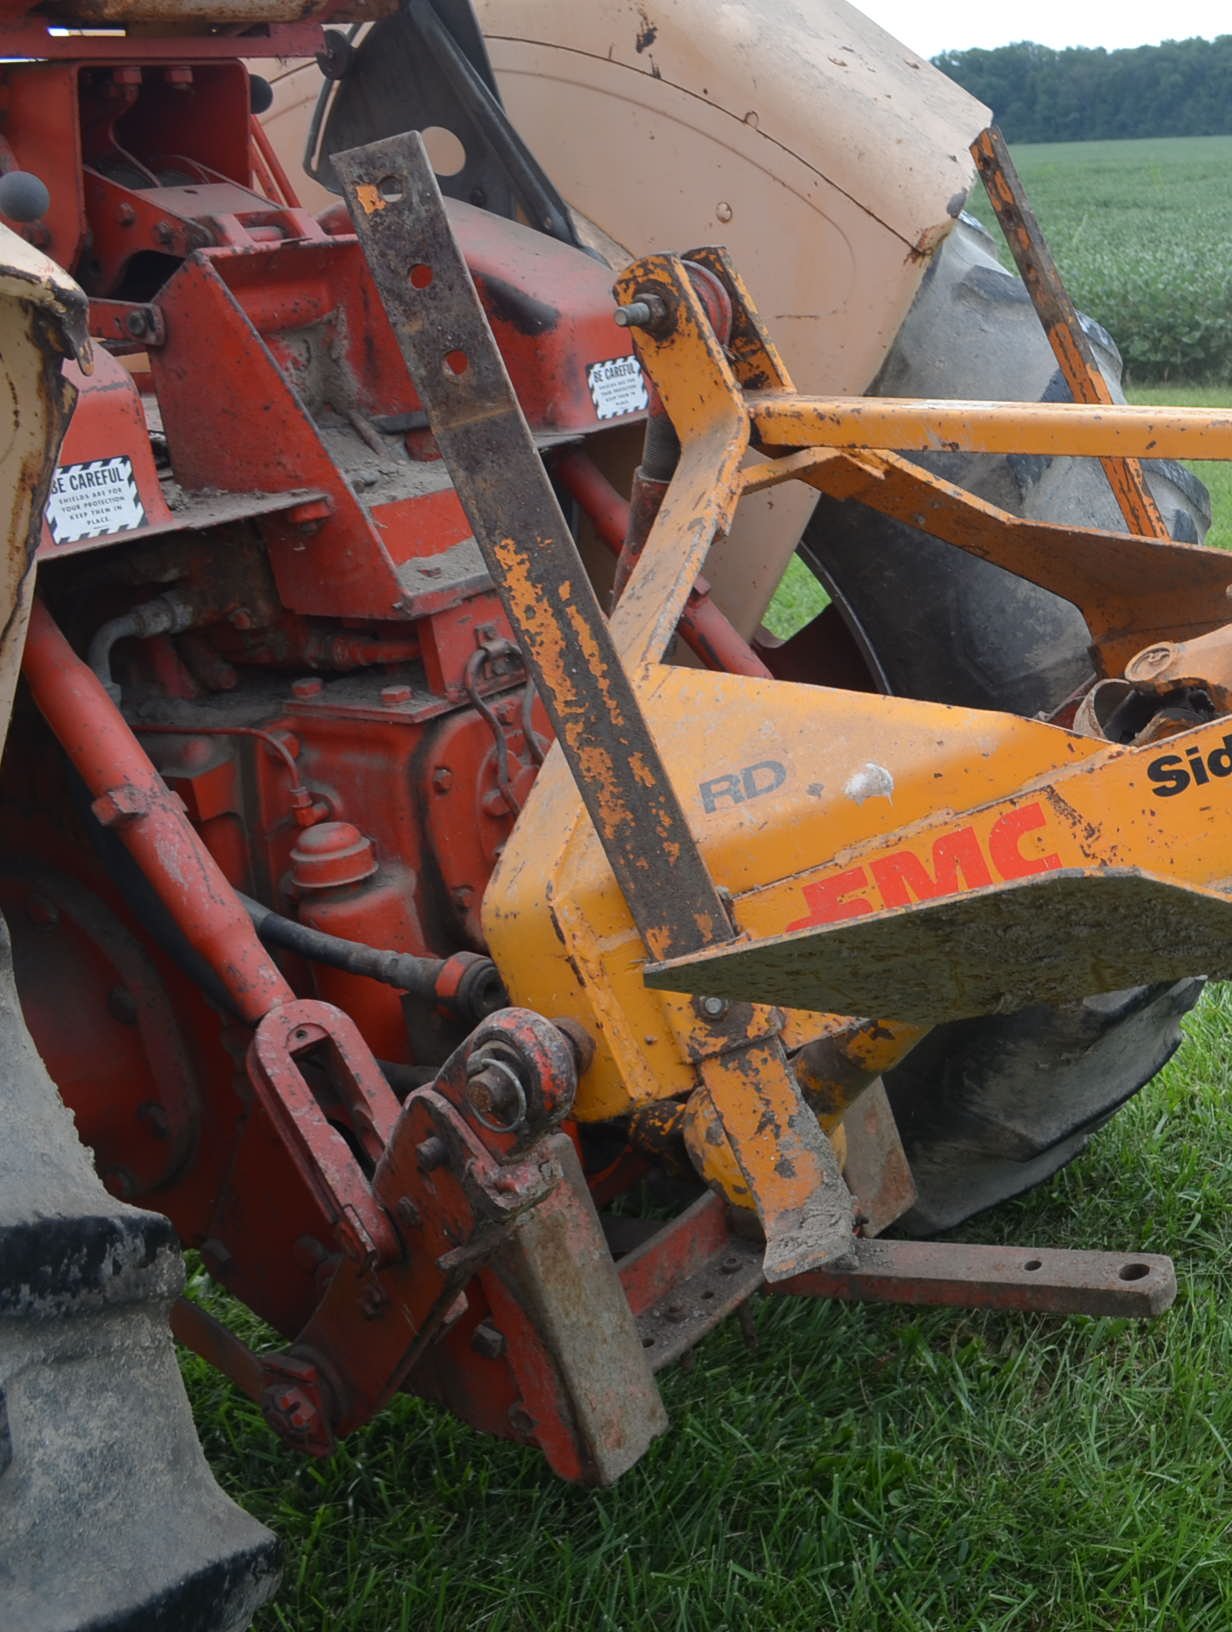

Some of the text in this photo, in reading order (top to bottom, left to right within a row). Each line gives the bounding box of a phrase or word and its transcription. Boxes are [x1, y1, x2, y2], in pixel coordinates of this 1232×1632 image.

[69, 467, 124, 492] CAREFUL
[59, 487, 122, 504] SHIELDS ARE FOR
[62, 496, 125, 512] YOUR PROTECTION
[70, 512, 88, 520] KEEP
[91, 508, 111, 516] THEM
[699, 760, 787, 814] RD
